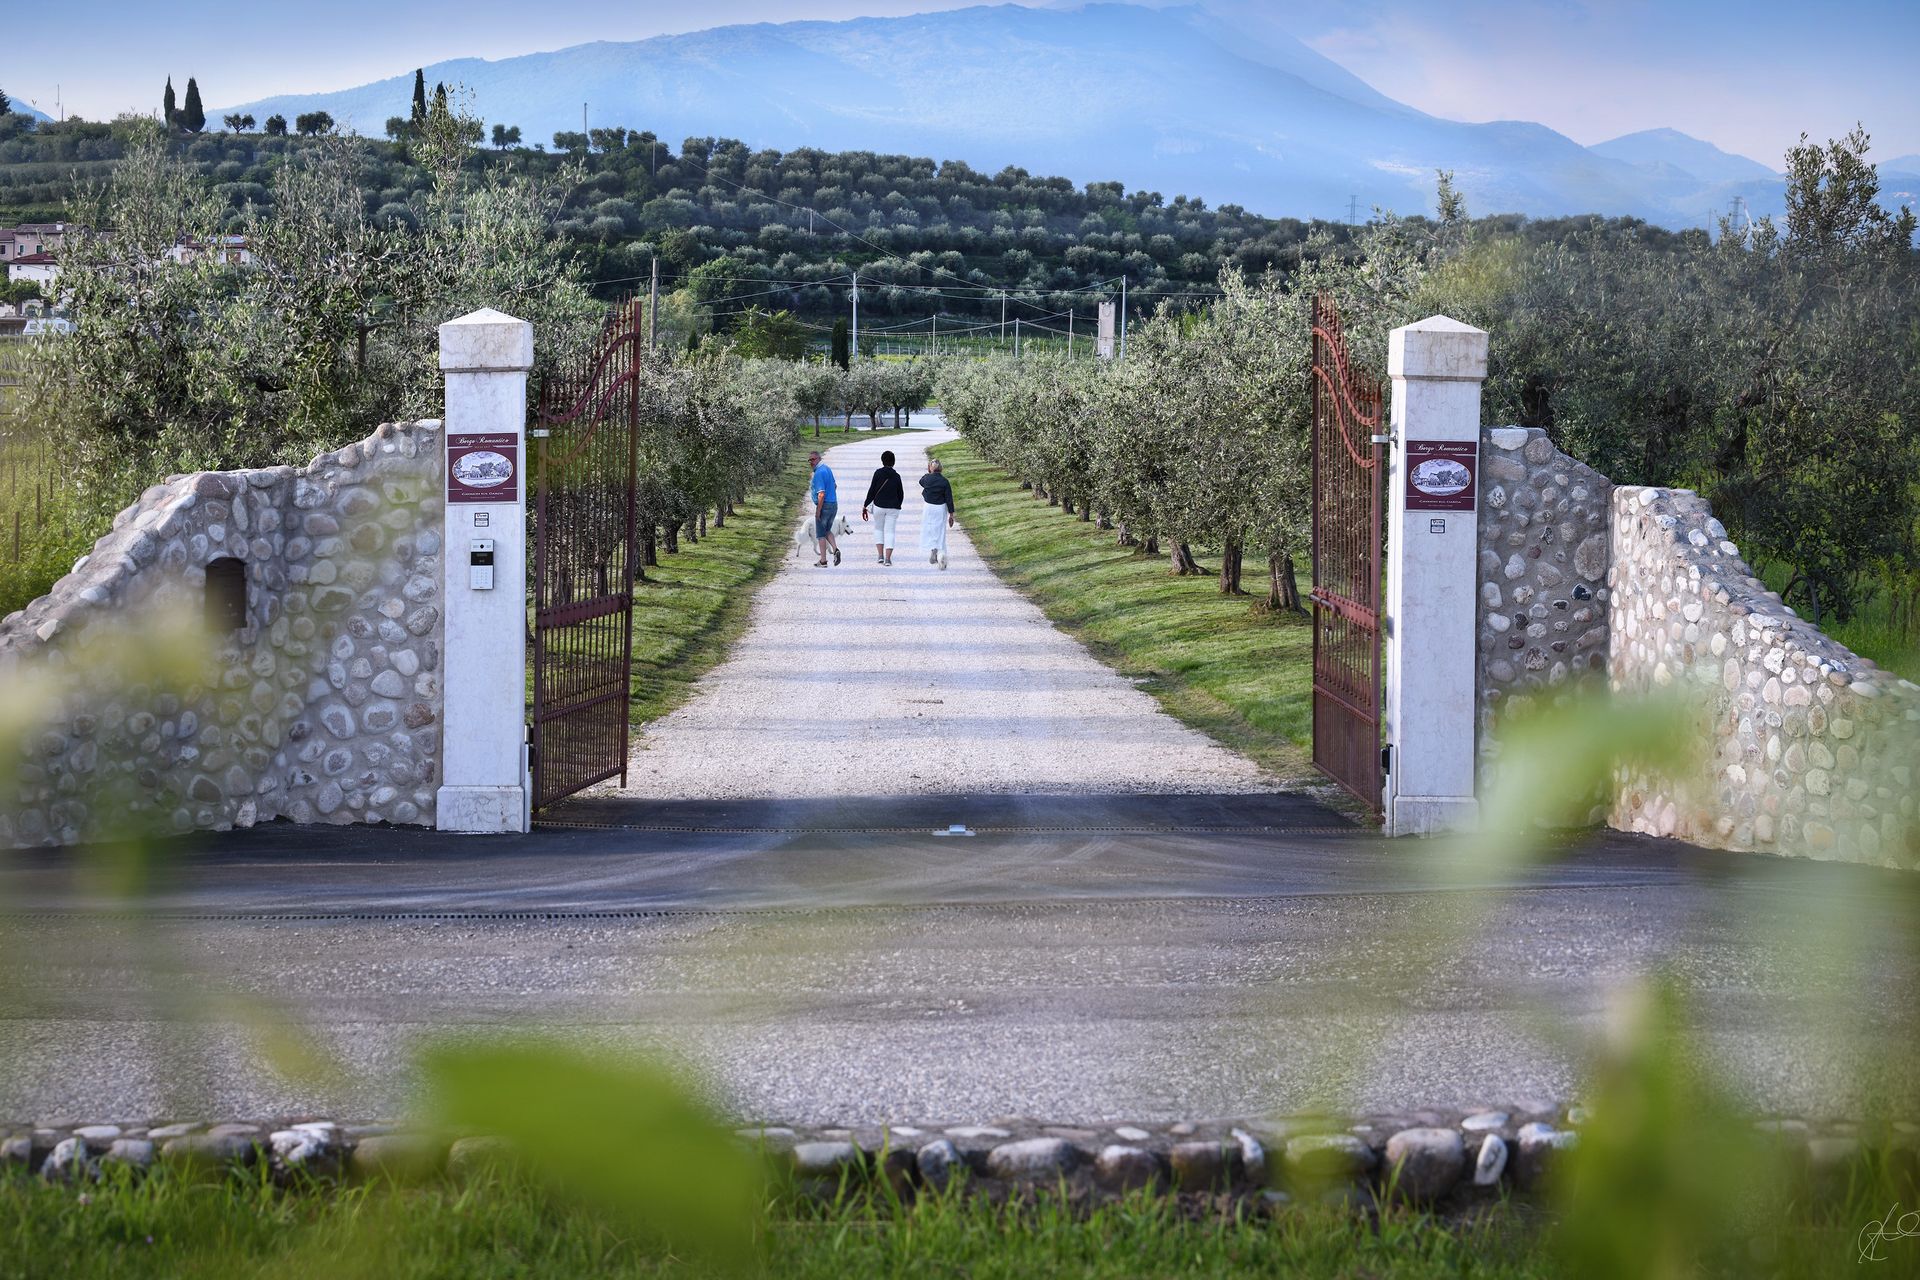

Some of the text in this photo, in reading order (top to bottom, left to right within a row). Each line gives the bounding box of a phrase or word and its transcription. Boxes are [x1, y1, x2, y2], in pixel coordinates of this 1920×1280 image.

[456, 435, 510, 446] Borgo Romantico
[1415, 443, 1469, 454] Borgo Romantico
